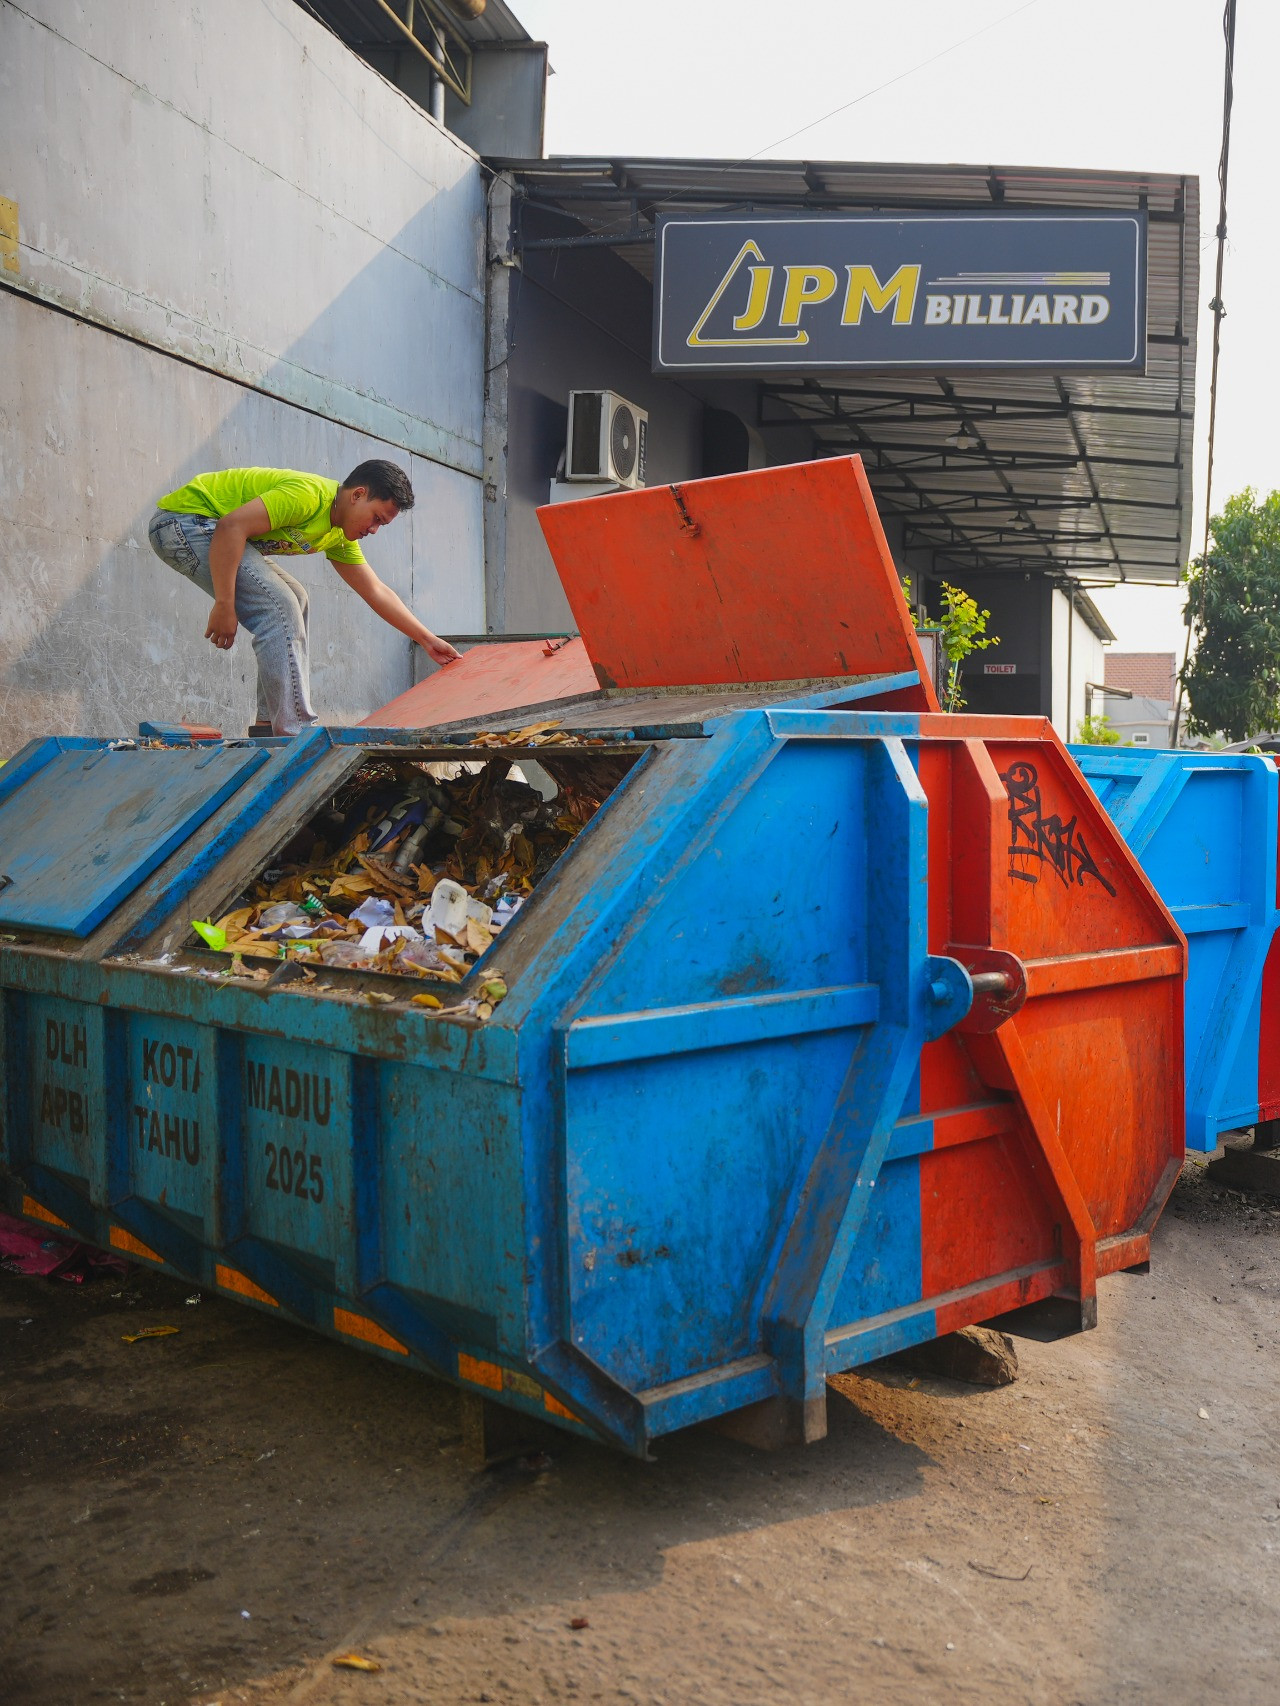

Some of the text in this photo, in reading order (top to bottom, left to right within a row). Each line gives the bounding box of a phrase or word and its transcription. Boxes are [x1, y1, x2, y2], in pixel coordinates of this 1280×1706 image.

[733, 264, 922, 332] JPM
[924, 294, 1111, 326] BILLIARD
[985, 665, 1014, 673] TOILET
[46, 1019, 88, 1069] DLH
[40, 1083, 89, 1136] APB
[265, 1142, 325, 1204] 2025
